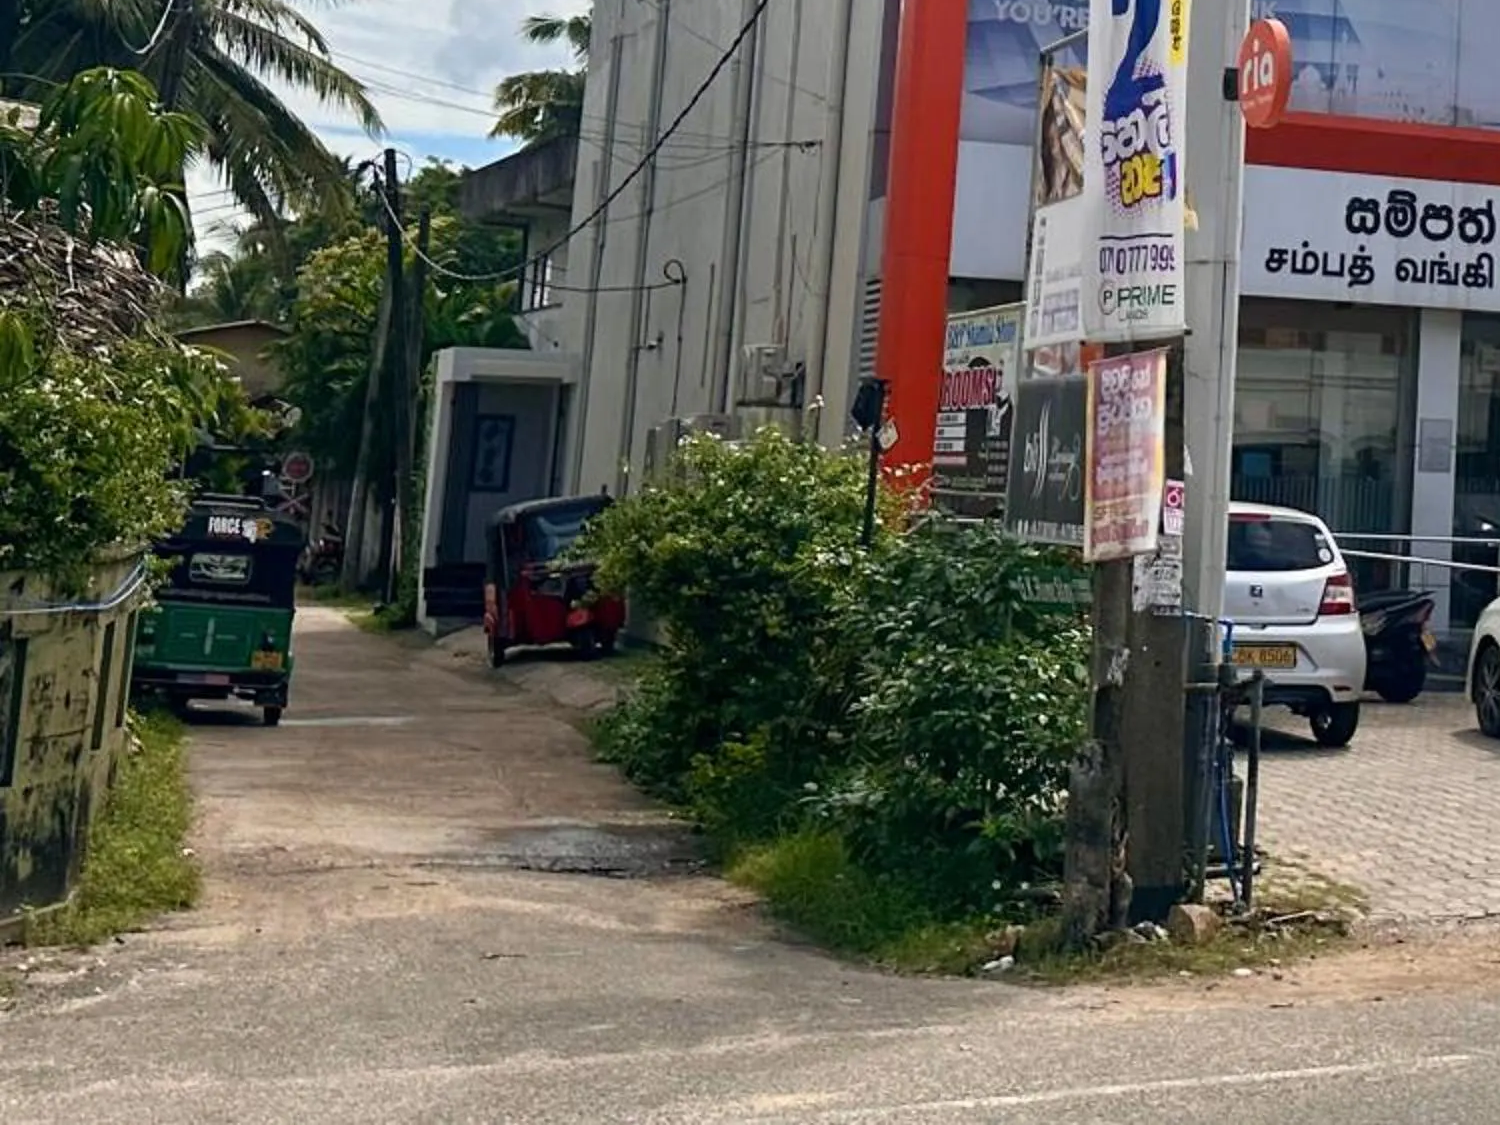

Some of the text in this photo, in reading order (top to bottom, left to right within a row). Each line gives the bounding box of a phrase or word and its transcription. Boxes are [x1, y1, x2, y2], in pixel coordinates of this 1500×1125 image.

[1242, 38, 1274, 95] ria
[1345, 189, 1496, 244] සම්පත්
[1265, 240, 1375, 288] சம்பத்
[1395, 251, 1494, 289] வங்கி
[1117, 284, 1176, 308] PRIME
[207, 516, 241, 535] FORCE
